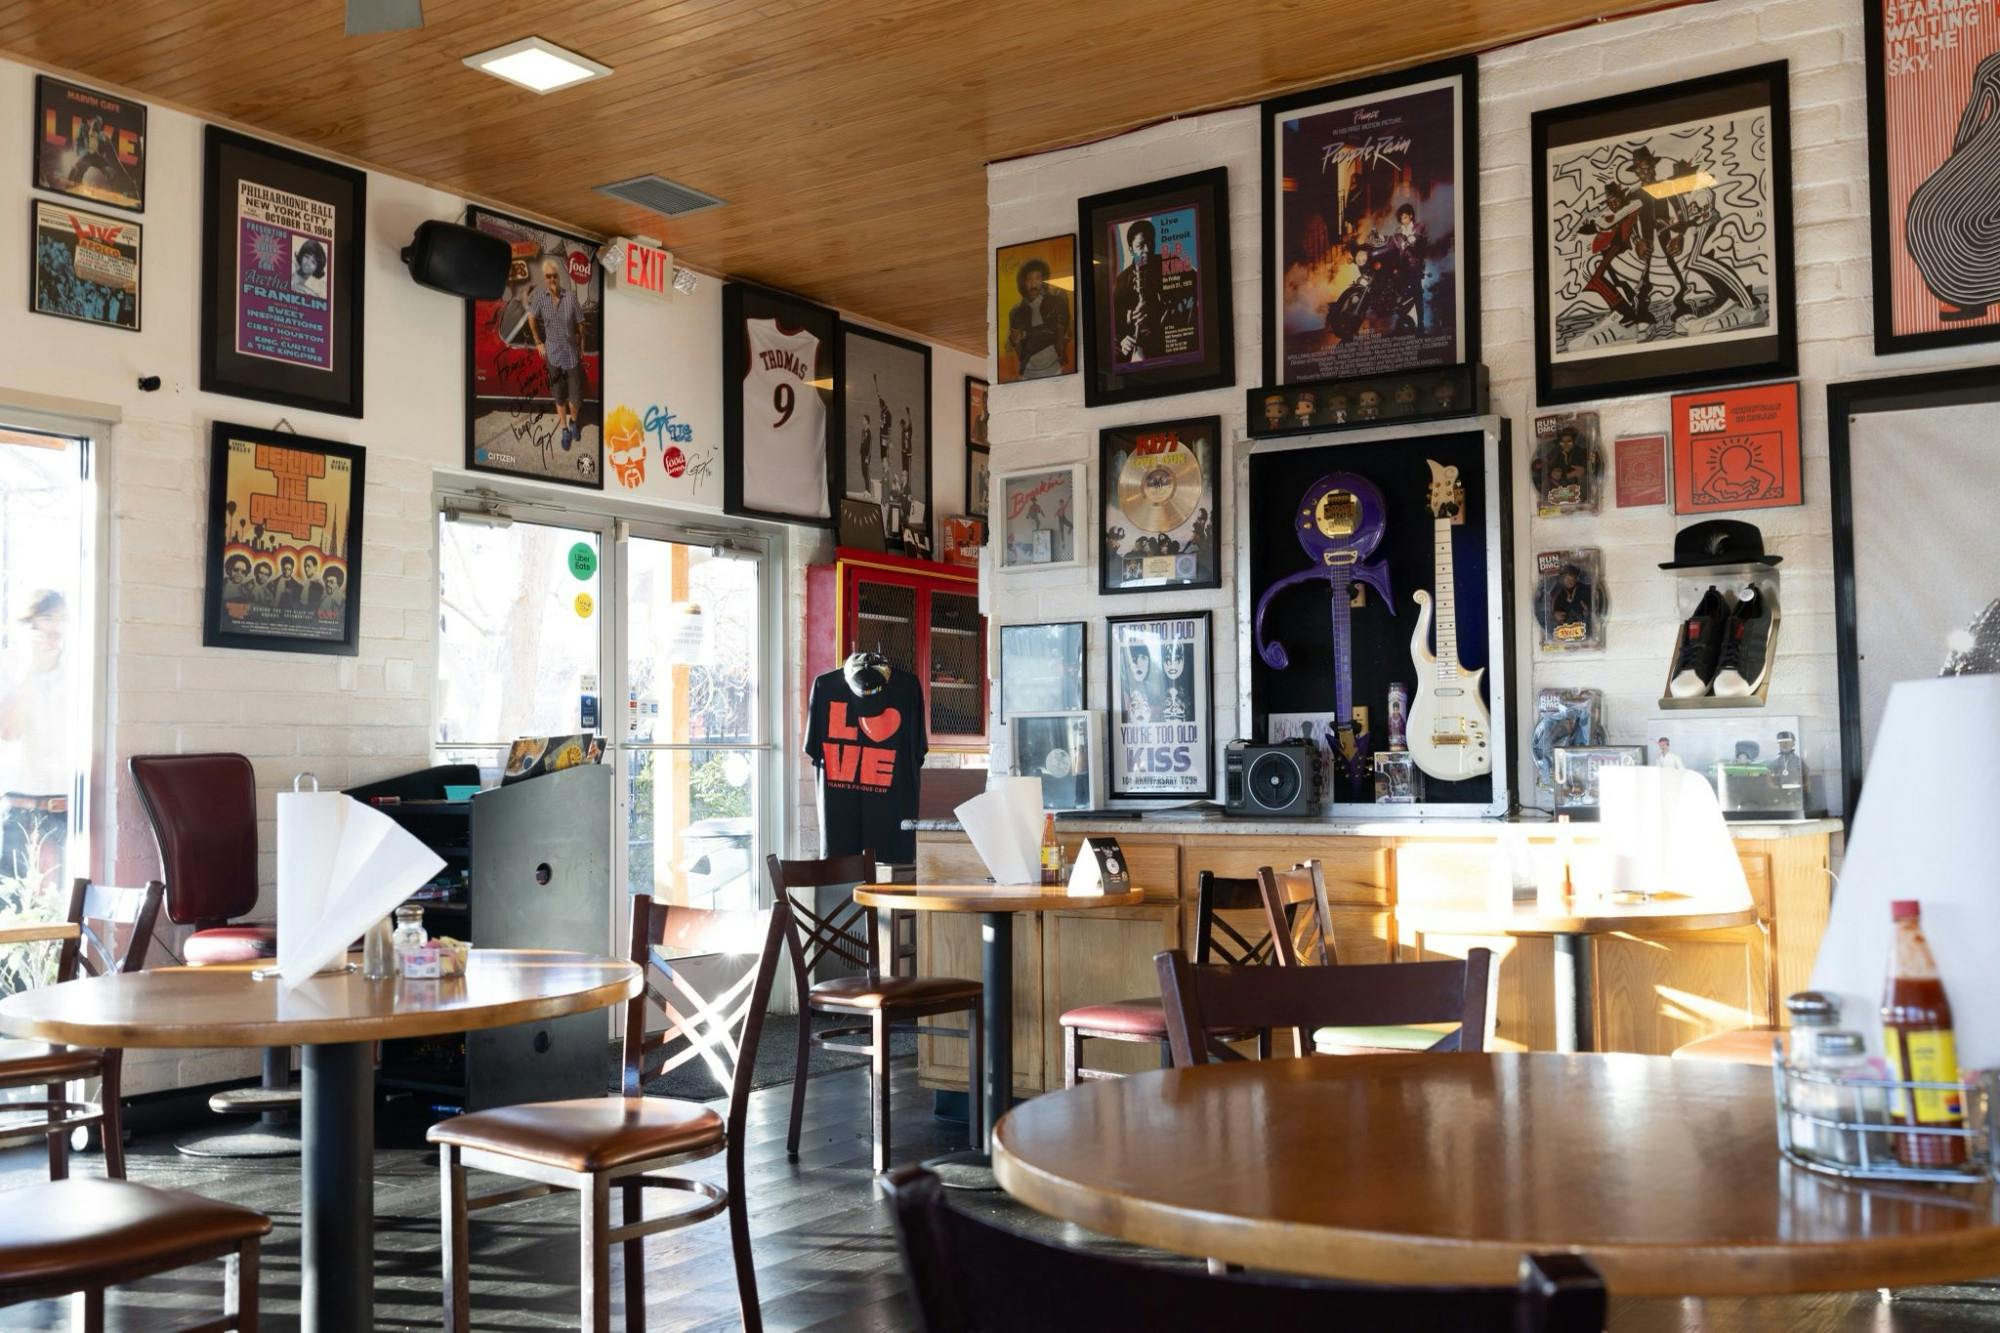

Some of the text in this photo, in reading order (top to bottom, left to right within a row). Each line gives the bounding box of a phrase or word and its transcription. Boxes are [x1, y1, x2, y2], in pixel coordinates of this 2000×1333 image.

[1886, 8, 1980, 41] WAITING
[1887, 31, 1958, 59] IN THE
[1887, 55, 1934, 77] SKY.
[1321, 135, 1412, 174] Purple Rain
[241, 183, 333, 219] PHILHARMONIC HALL
[245, 197, 270, 211] NEW
[274, 204, 301, 219] YORK
[304, 212, 328, 226] CITY
[66, 213, 124, 245] LIVE
[265, 212, 301, 231] OCTOBER
[314, 225, 333, 239] 1968
[1161, 217, 1178, 226] Live
[1161, 231, 1191, 243] Detroit
[568, 258, 592, 275] food
[626, 242, 668, 294] EXIT
[246, 270, 289, 290] Aretha
[243, 283, 328, 312] FRANKLIN
[247, 309, 323, 332] INSPIRATIONS
[267, 305, 304, 320] SWEET
[254, 335, 279, 346] KING
[281, 340, 316, 354] CURTIS
[277, 328, 324, 344] HOUSTON
[257, 343, 275, 353] THE
[277, 348, 323, 362] KINGPINS
[758, 348, 808, 380] THOMAS
[772, 382, 795, 429] 9
[1689, 405, 1726, 421] RUN
[1536, 418, 1557, 429] RUN
[1537, 425, 1557, 434] DMC
[1690, 418, 1727, 435] DMC
[1135, 432, 1179, 456] KISS
[487, 451, 516, 464] CITIZEN
[665, 453, 685, 472] food
[1163, 454, 1186, 465] GUN
[903, 527, 931, 551] ALI
[574, 553, 591, 563] Uber
[574, 562, 591, 572] Eats
[1539, 555, 1560, 564] RUN
[1540, 562, 1560, 571] DMC
[1149, 622, 1168, 641] TOO
[1171, 620, 1195, 641] LOUD
[1540, 695, 1560, 703] RUN
[1120, 725, 1198, 745] YOU'RE TOO OLD!
[1126, 746, 1192, 773] KISS
[1134, 775, 1178, 786] ANNIVERSARY
